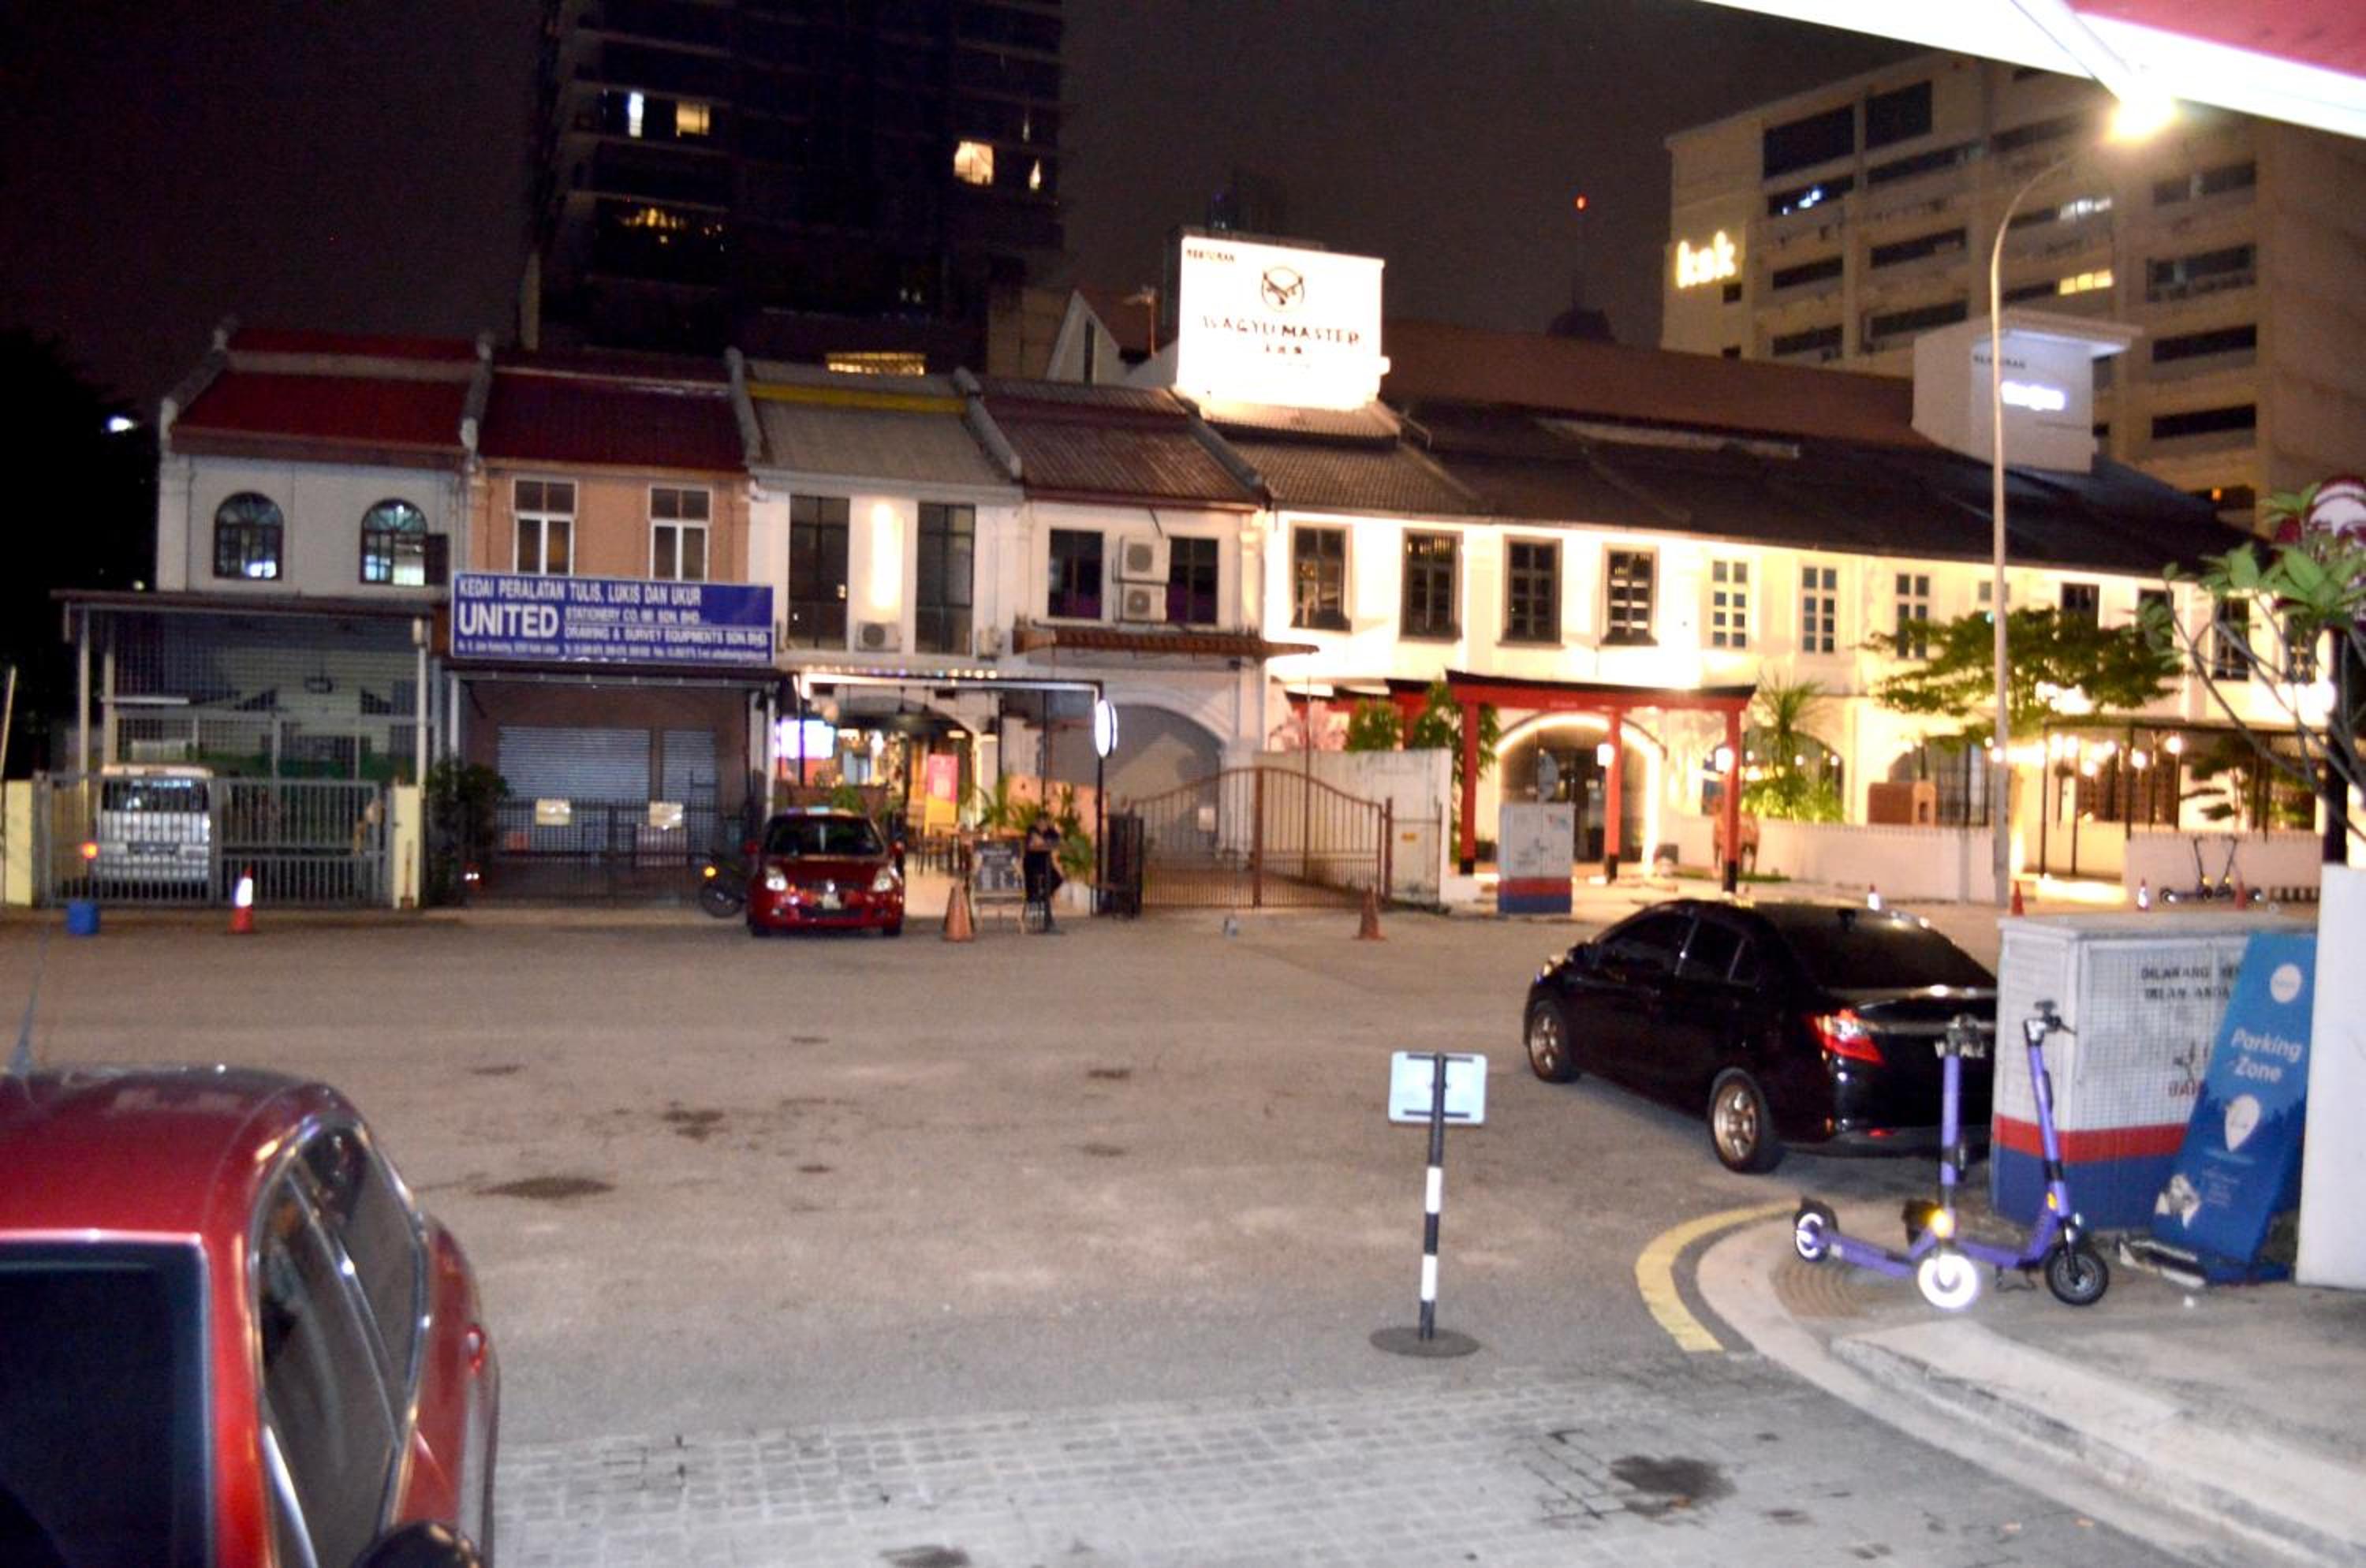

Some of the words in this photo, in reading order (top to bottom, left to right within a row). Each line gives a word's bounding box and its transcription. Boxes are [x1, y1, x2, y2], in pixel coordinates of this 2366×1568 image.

[459, 578, 494, 598] KEDAI
[498, 579, 565, 600] PERALATAN
[569, 582, 605, 603] TULIS,
[608, 584, 640, 604] LUKIS
[644, 585, 667, 605] DAN
[671, 586, 702, 607] UKUR
[458, 602, 559, 639] UNITED
[2230, 1027, 2302, 1063] Parking
[2234, 1056, 2282, 1084] Zone
